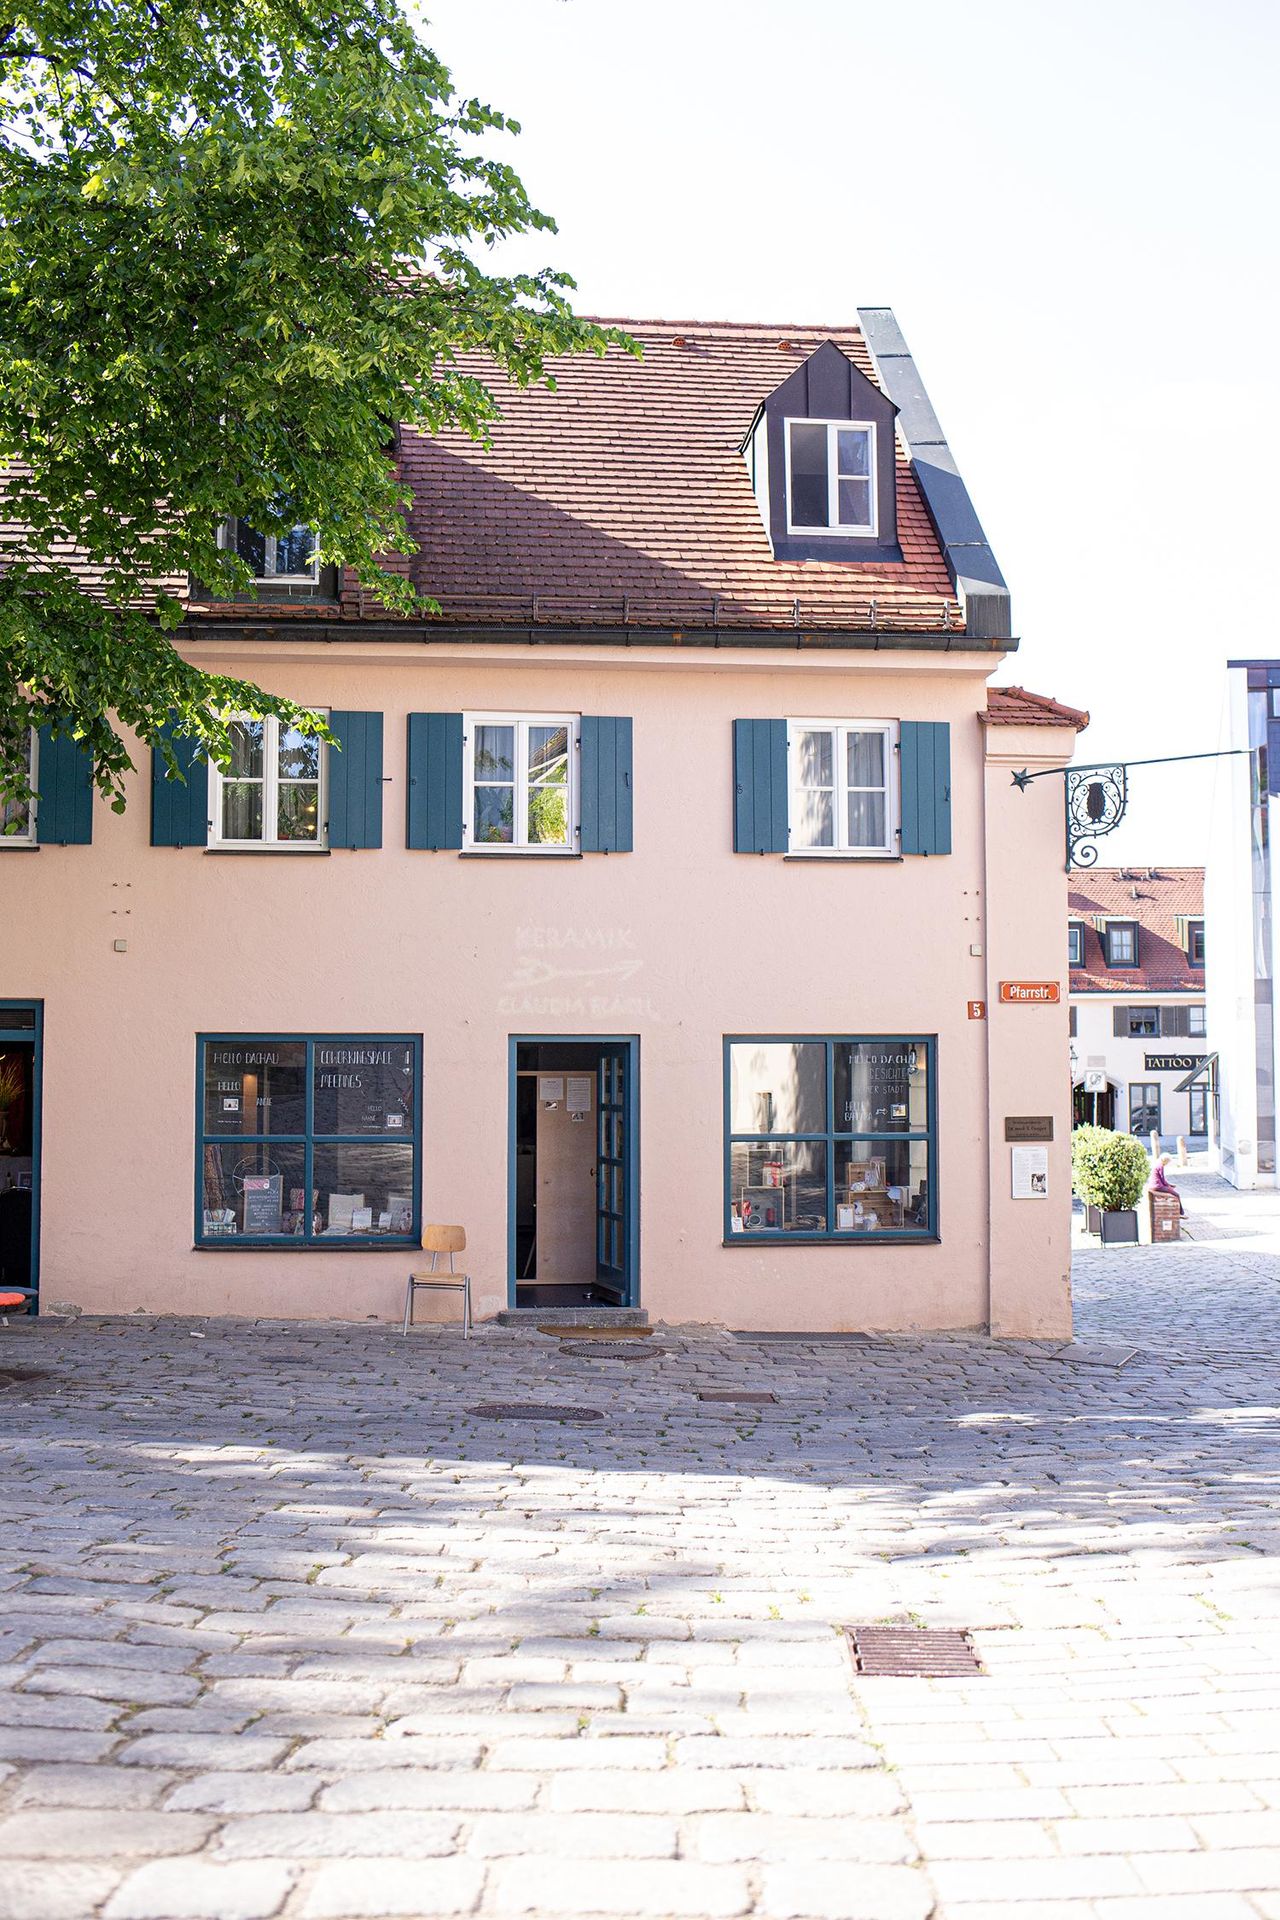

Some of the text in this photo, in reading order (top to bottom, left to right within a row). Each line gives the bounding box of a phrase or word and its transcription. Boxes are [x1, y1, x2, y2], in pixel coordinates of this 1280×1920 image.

[514, 925, 637, 950] KERAMIK
[1010, 985, 1051, 998] Pfarrstr.
[973, 1003, 980, 1017] 5
[1146, 1057, 1192, 1068] TATTOO
